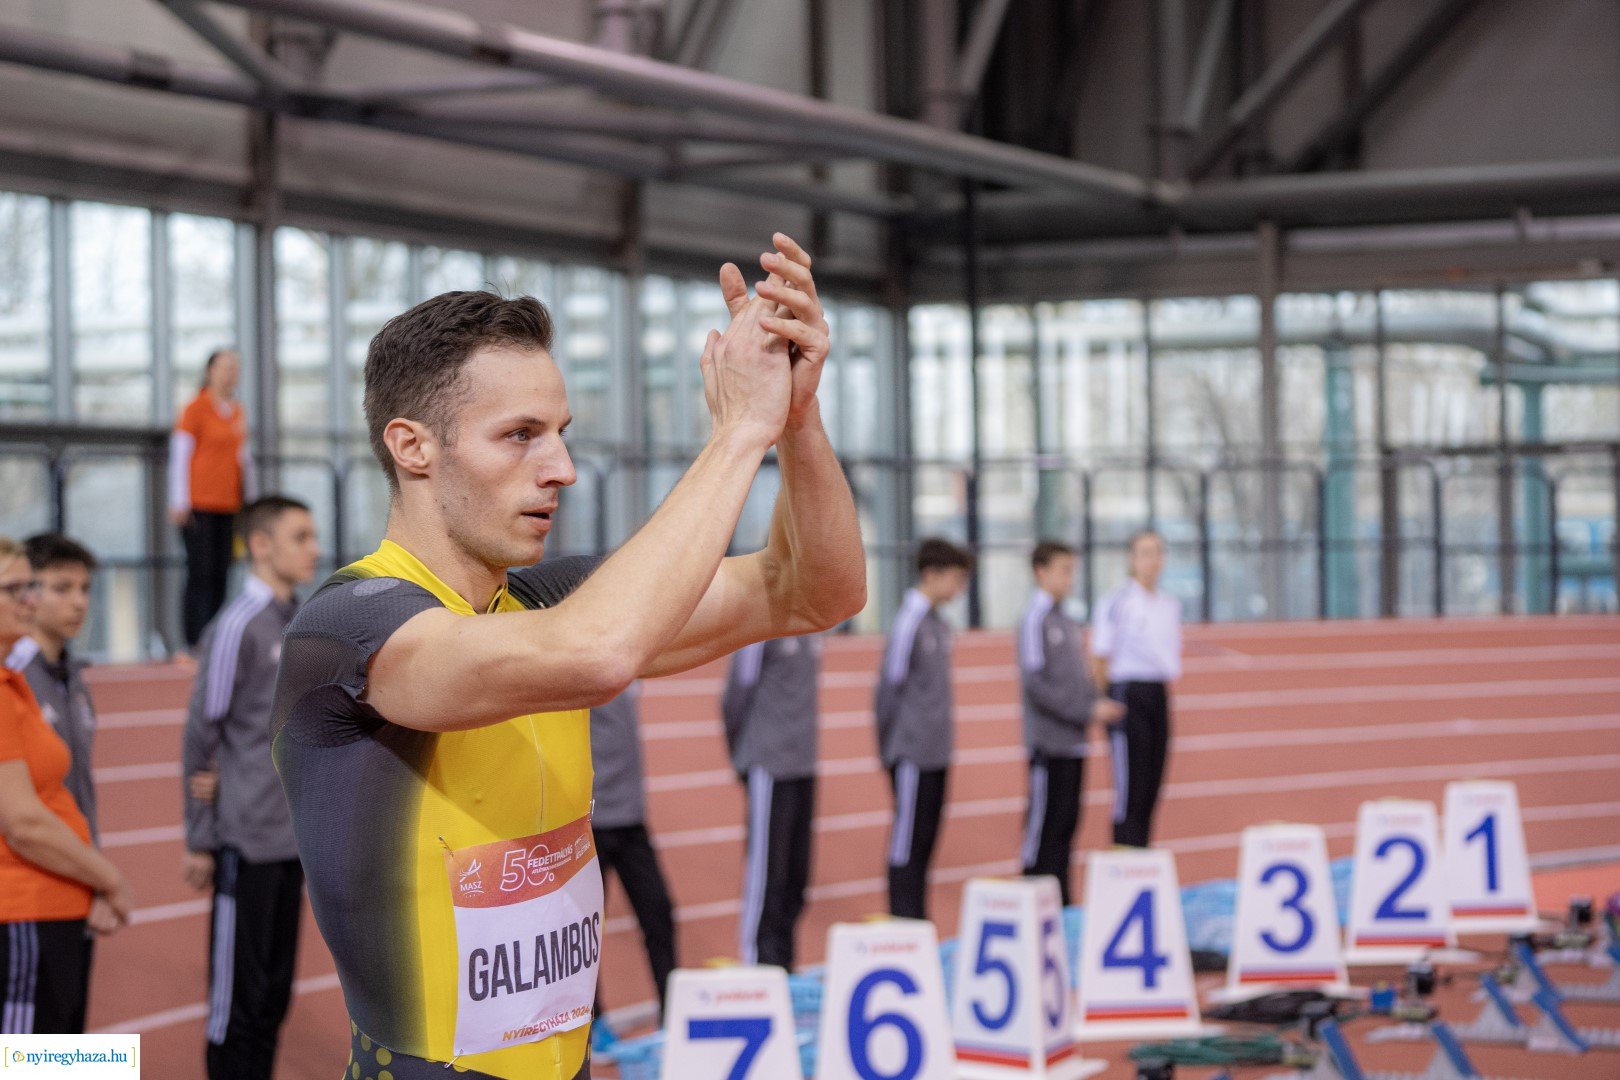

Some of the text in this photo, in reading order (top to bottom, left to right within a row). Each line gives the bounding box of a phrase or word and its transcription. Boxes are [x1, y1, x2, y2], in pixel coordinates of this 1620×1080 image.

[460, 880, 483, 892] MASZ
[1374, 836, 1429, 920] 2
[1464, 811, 1498, 894] 1
[1102, 886, 1169, 989] 4
[1260, 862, 1316, 954] 3
[468, 911, 600, 1002] GALAMBOS
[971, 921, 1020, 1031] 5
[1041, 916, 1066, 1030] 5
[571, 1004, 590, 1019] 2024
[687, 1017, 774, 1080] 7
[846, 968, 925, 1080] 6
